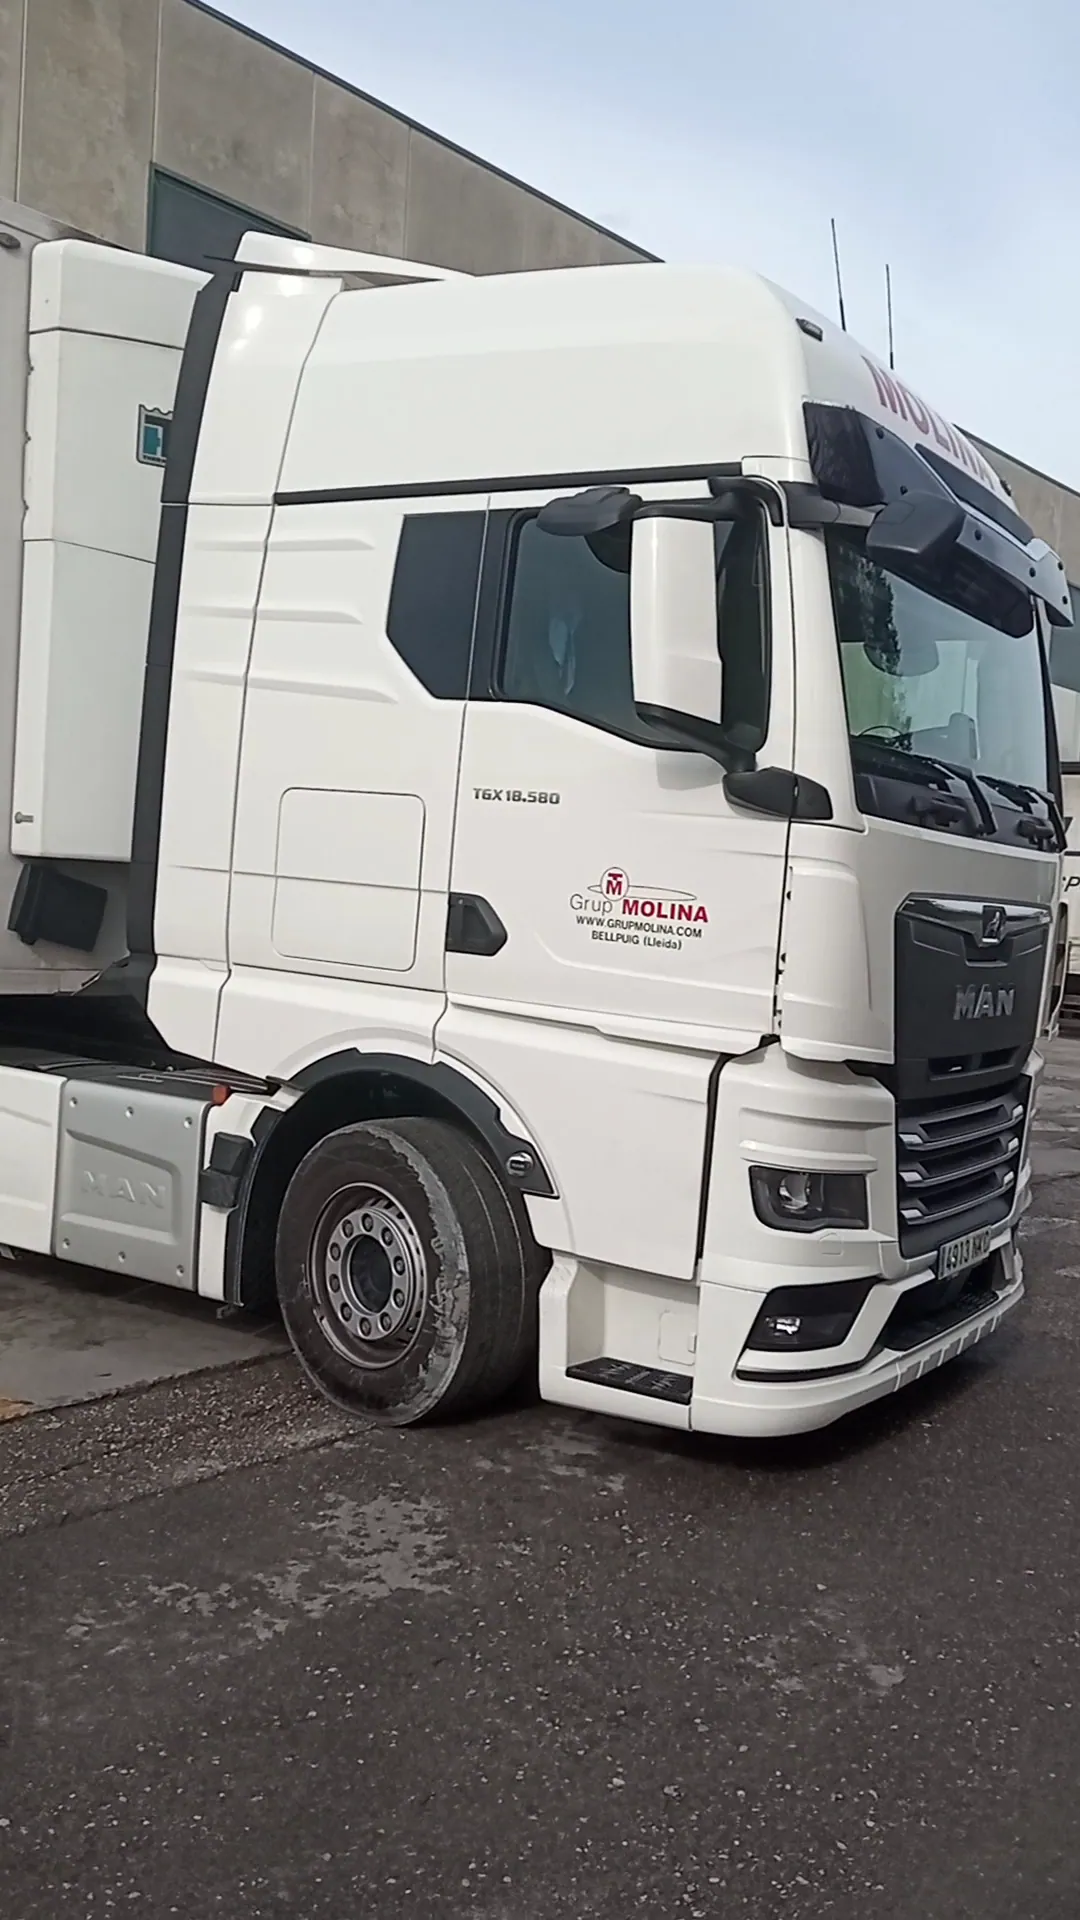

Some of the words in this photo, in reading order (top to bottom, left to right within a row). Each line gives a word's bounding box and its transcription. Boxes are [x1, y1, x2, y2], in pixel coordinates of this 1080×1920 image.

[473, 788, 503, 801] TGX
[505, 789, 561, 805] 18.580
[569, 893, 613, 916] Grup
[622, 899, 709, 923] MOLINA
[576, 915, 702, 938] WWW.GRUPMOLINA.COM
[591, 930, 640, 945] BELLPUIG
[643, 936, 683, 950] (Lleida)
[953, 985, 1014, 1020] MAN
[81, 1170, 166, 1209] MAN
